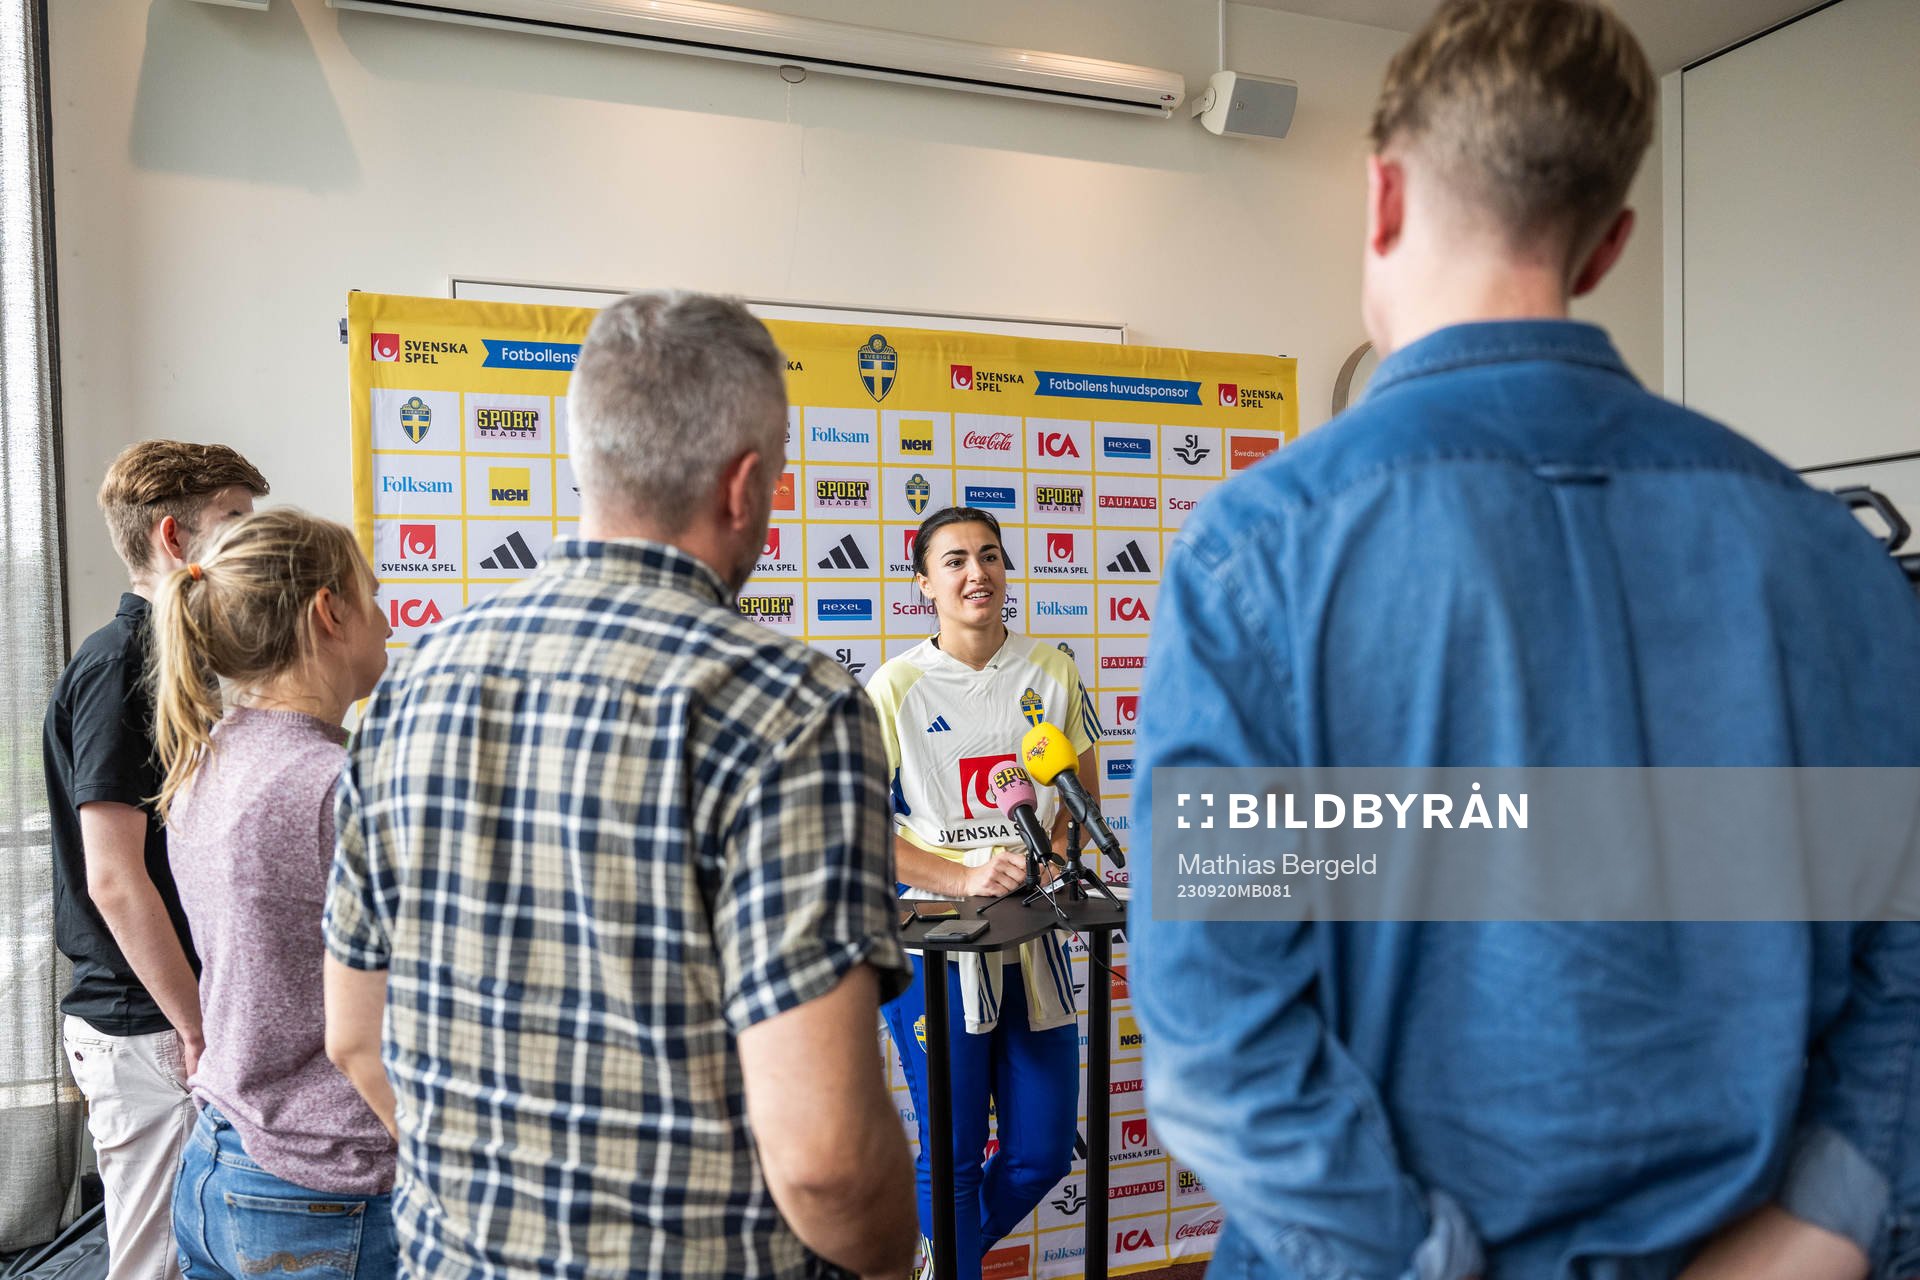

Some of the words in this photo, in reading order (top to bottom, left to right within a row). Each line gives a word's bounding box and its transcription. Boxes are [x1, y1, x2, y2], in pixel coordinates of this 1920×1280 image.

[405, 340, 468, 354] SVENSKA
[405, 353, 438, 364] SPEL
[502, 347, 577, 364] Fotbollens
[976, 371, 1024, 384] SVENSKA
[977, 382, 1002, 393] SPEL
[1050, 378, 1108, 393] Fotbollens
[1110, 381, 1188, 399] huvudsponsor
[1240, 389, 1284, 400] SVENSKA
[1240, 399, 1263, 408] SPEL
[477, 408, 538, 431] SPORT
[480, 430, 537, 438] BLADET
[811, 427, 869, 443] Folksam
[963, 431, 1014, 451] Coca-Cola
[1185, 434, 1198, 449] SJ
[1038, 432, 1080, 458] ICA
[1234, 449, 1265, 457] Swedbank
[382, 476, 453, 493] Folksam
[816, 480, 869, 500] SPORT
[1036, 487, 1083, 505] SPORT
[1100, 497, 1155, 507] BAUHAUS
[381, 563, 429, 572] SVENSKA
[432, 563, 456, 572] SPEL
[1034, 566, 1068, 574] SVENSKA
[1071, 566, 1088, 574] SPEL
[391, 599, 443, 627] ICA
[739, 597, 793, 616] SPORT
[1036, 601, 1088, 615] Folksam
[1110, 597, 1150, 621] ICA
[836, 648, 851, 664] SJ
[938, 825, 1009, 843] SVENSKA
[1110, 1152, 1142, 1161] SVENSKA
[1143, 1148, 1162, 1158] SPEL
[1063, 1184, 1077, 1199] SJ
[1109, 1181, 1164, 1198] BAUHAUS
[1115, 1228, 1155, 1253] ICA
